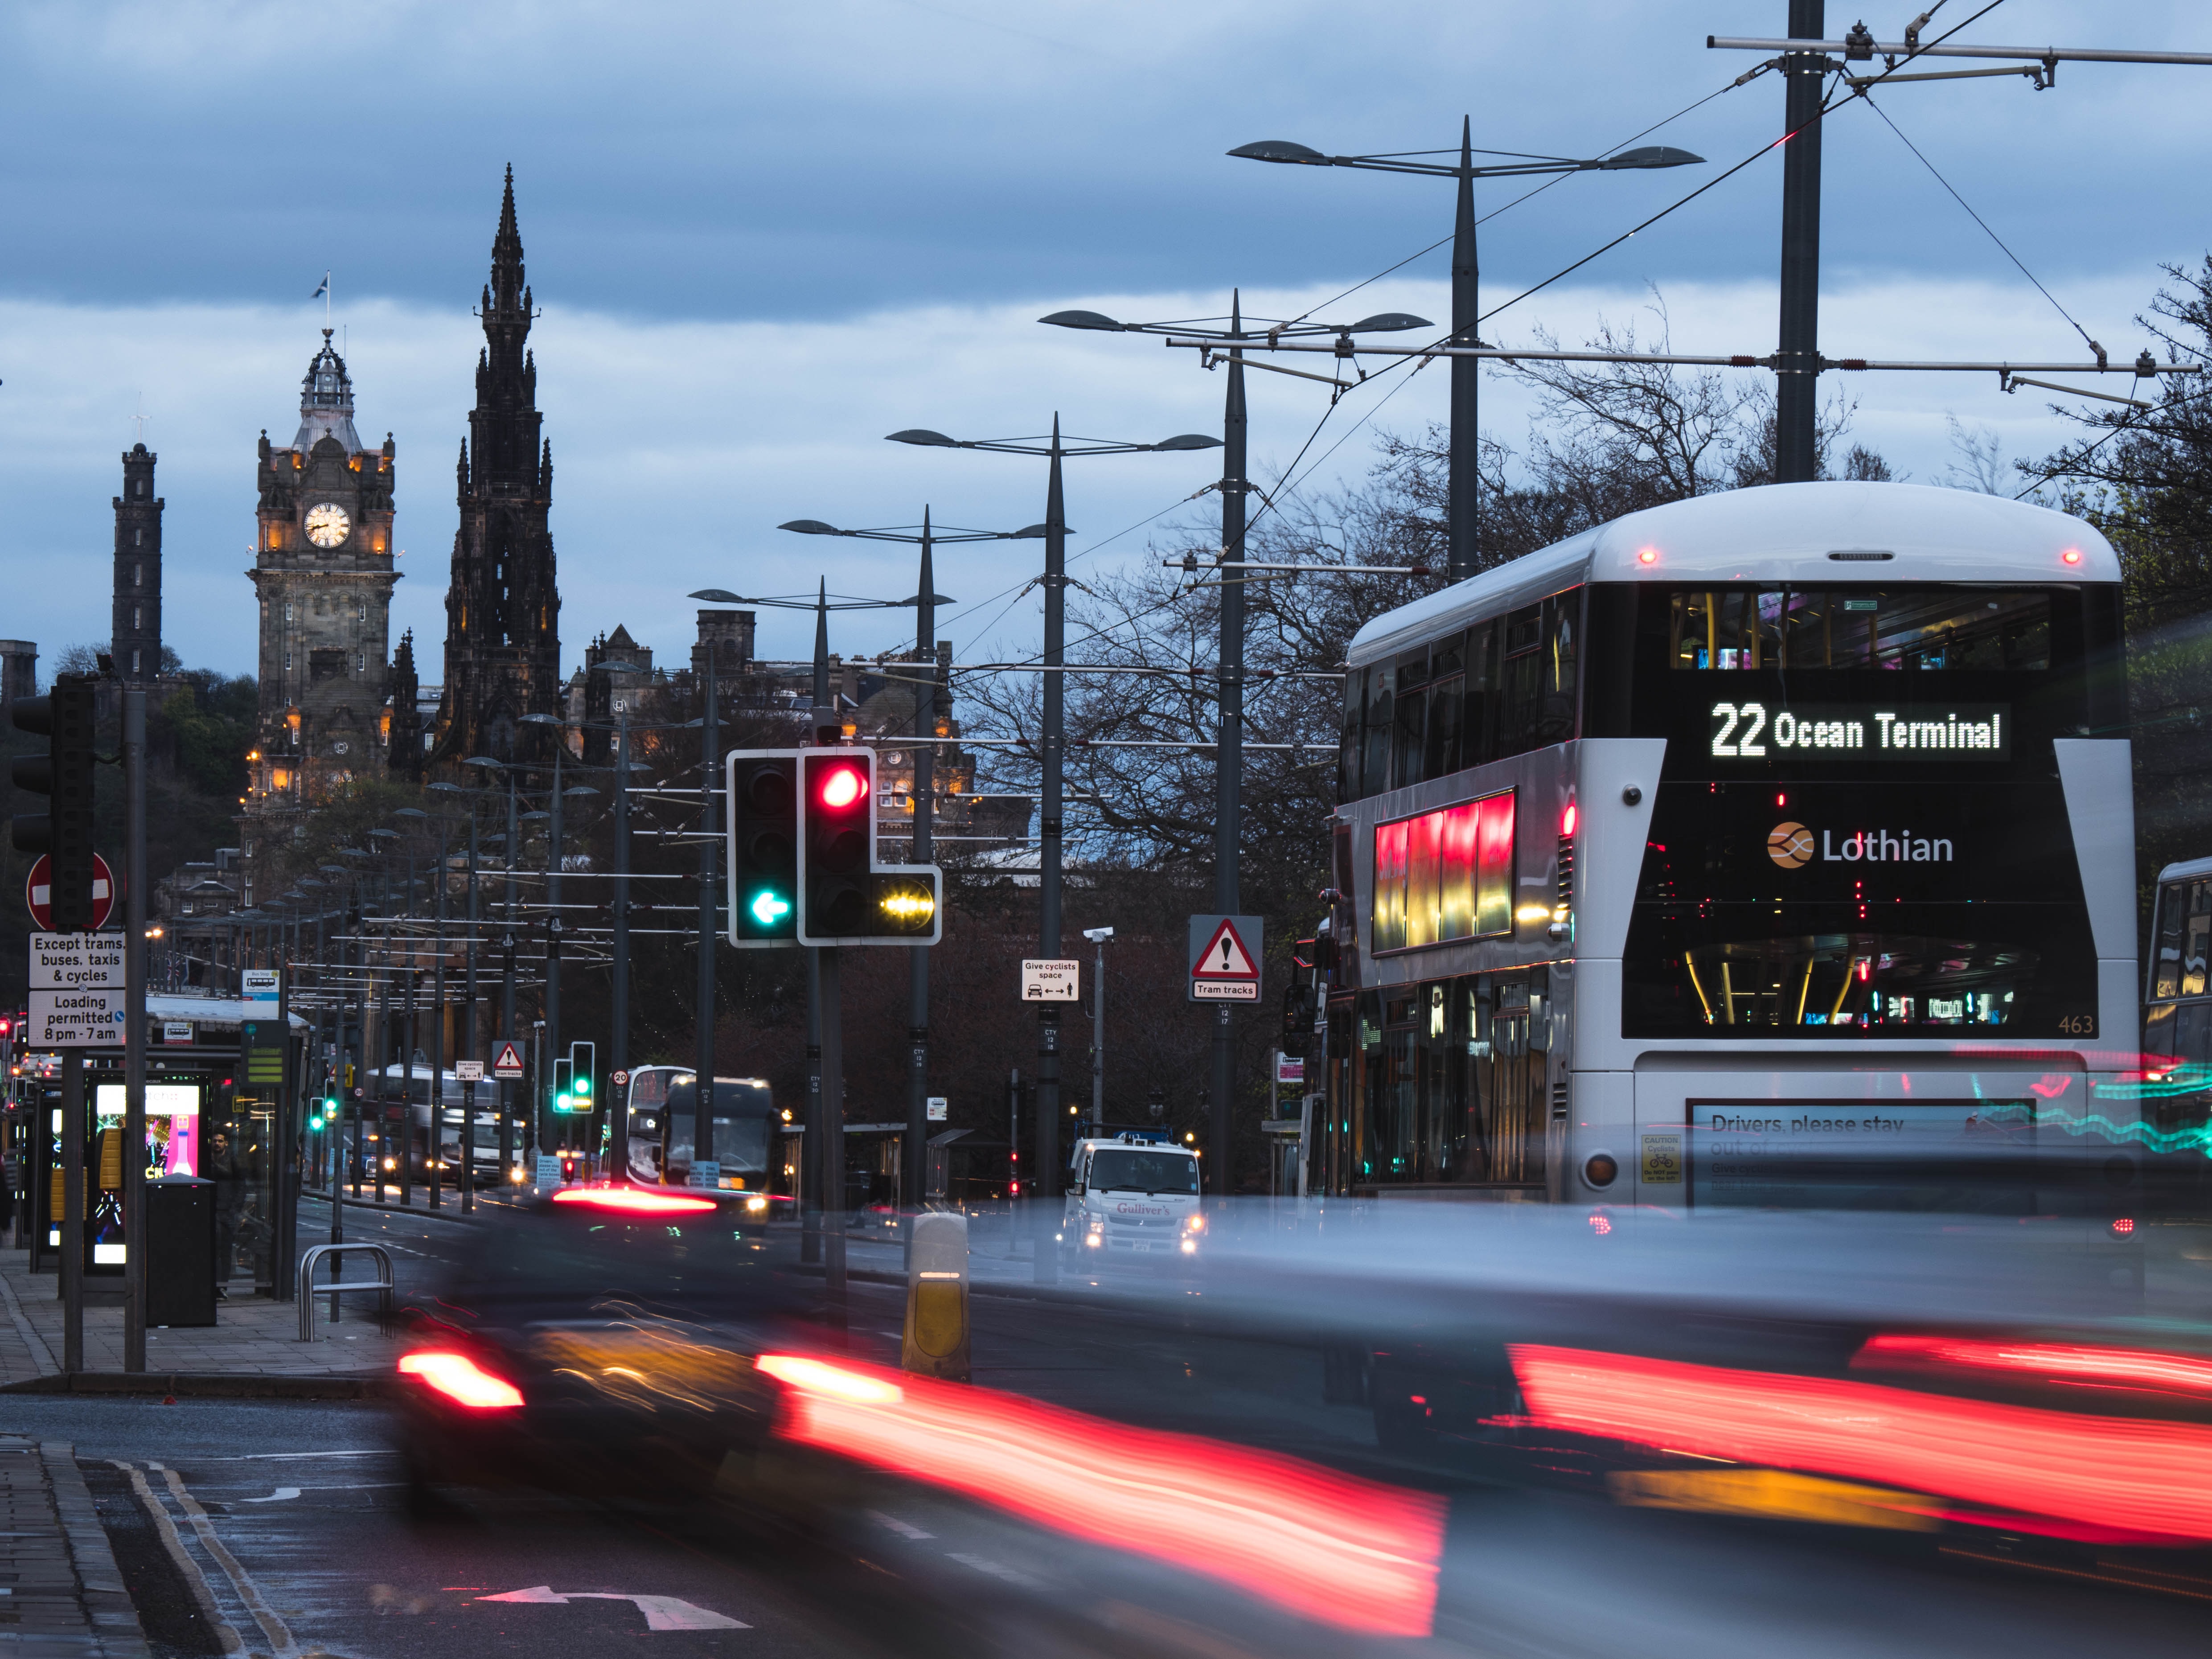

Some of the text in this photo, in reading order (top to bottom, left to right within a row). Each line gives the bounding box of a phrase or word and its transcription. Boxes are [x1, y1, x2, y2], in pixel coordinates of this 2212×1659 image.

[1711, 703, 2000, 756] 22 Ocean Terminal
[1824, 830, 1953, 862] Lothian
[35, 938, 126, 952] Except trams,
[41, 953, 120, 966] buses, taxis
[1045, 963, 1076, 971] cyclists
[53, 969, 108, 983] & cycles
[1198, 985, 1253, 994] Tram tracks
[55, 996, 106, 1010] Loading
[48, 1011, 112, 1026] permitted
[2058, 1016, 2094, 1034] 463
[45, 1028, 53, 1040] 8
[56, 1030, 76, 1042] pm
[86, 1027, 94, 1039] 7
[97, 1030, 116, 1039] am
[1712, 1115, 1904, 1136] Drivers, please stay
[1117, 1203, 1170, 1216] Gulliver's
